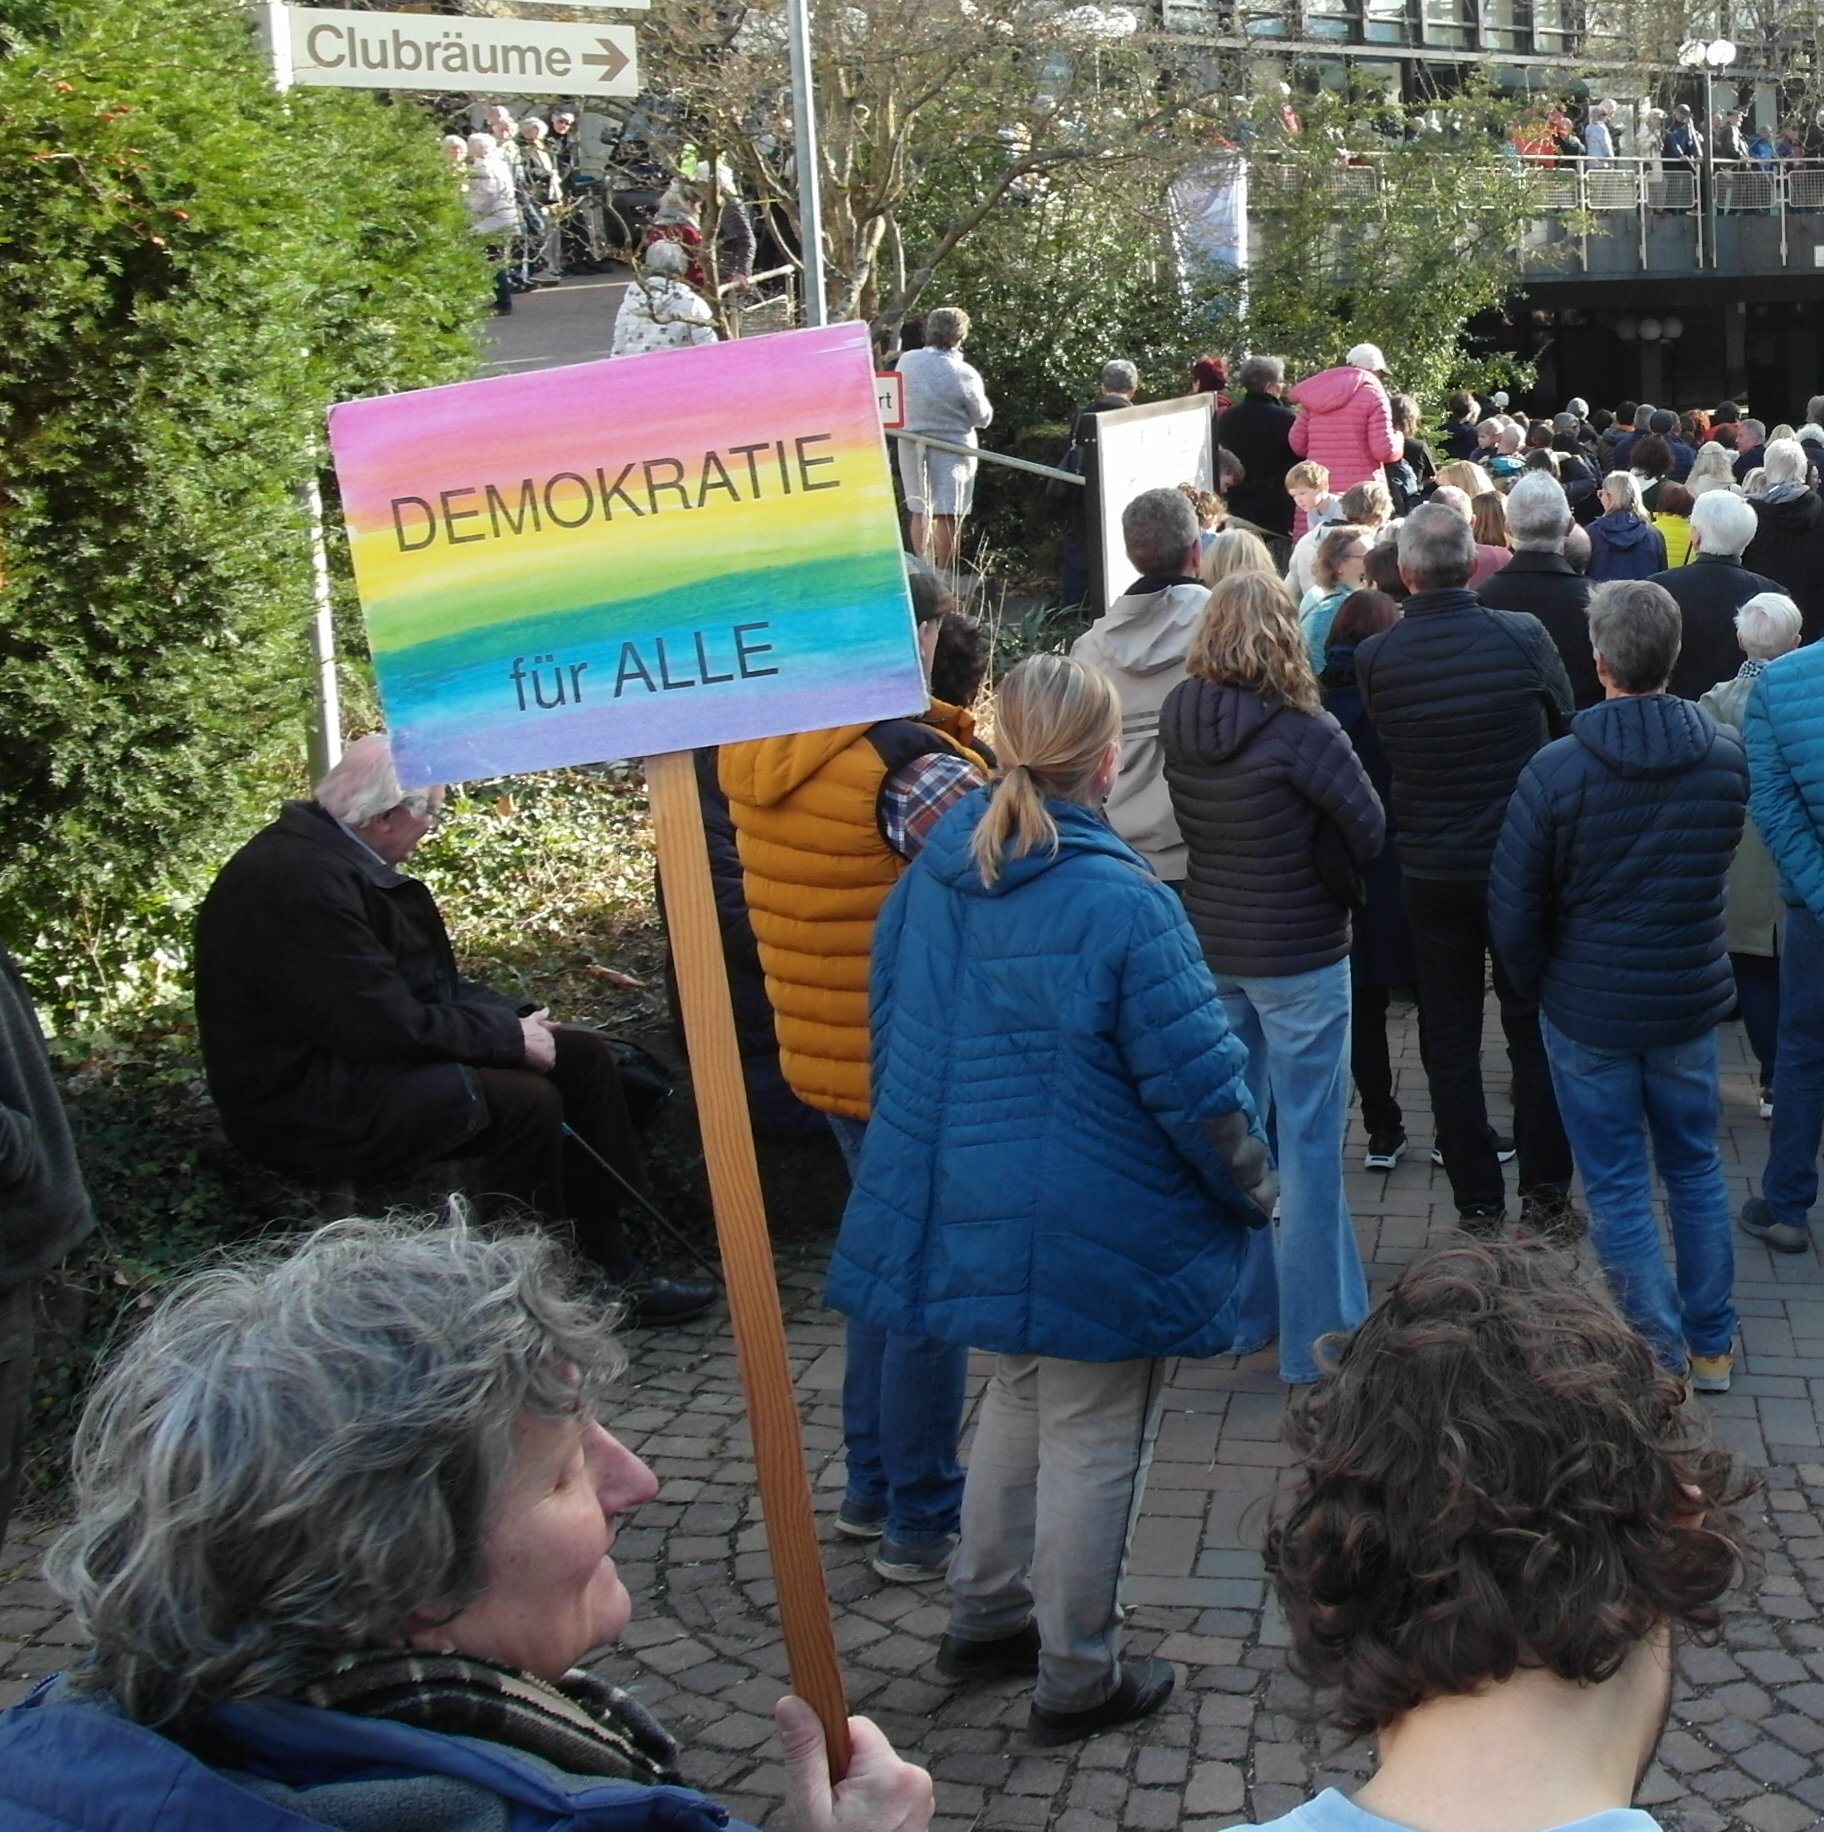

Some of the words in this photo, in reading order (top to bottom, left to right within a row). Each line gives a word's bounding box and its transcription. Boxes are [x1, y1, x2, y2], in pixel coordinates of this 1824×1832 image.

[307, 24, 572, 77] Clubräume
[391, 433, 840, 552] DEMOKRATIE
[509, 654, 588, 711] für
[614, 621, 779, 698] ALLE
